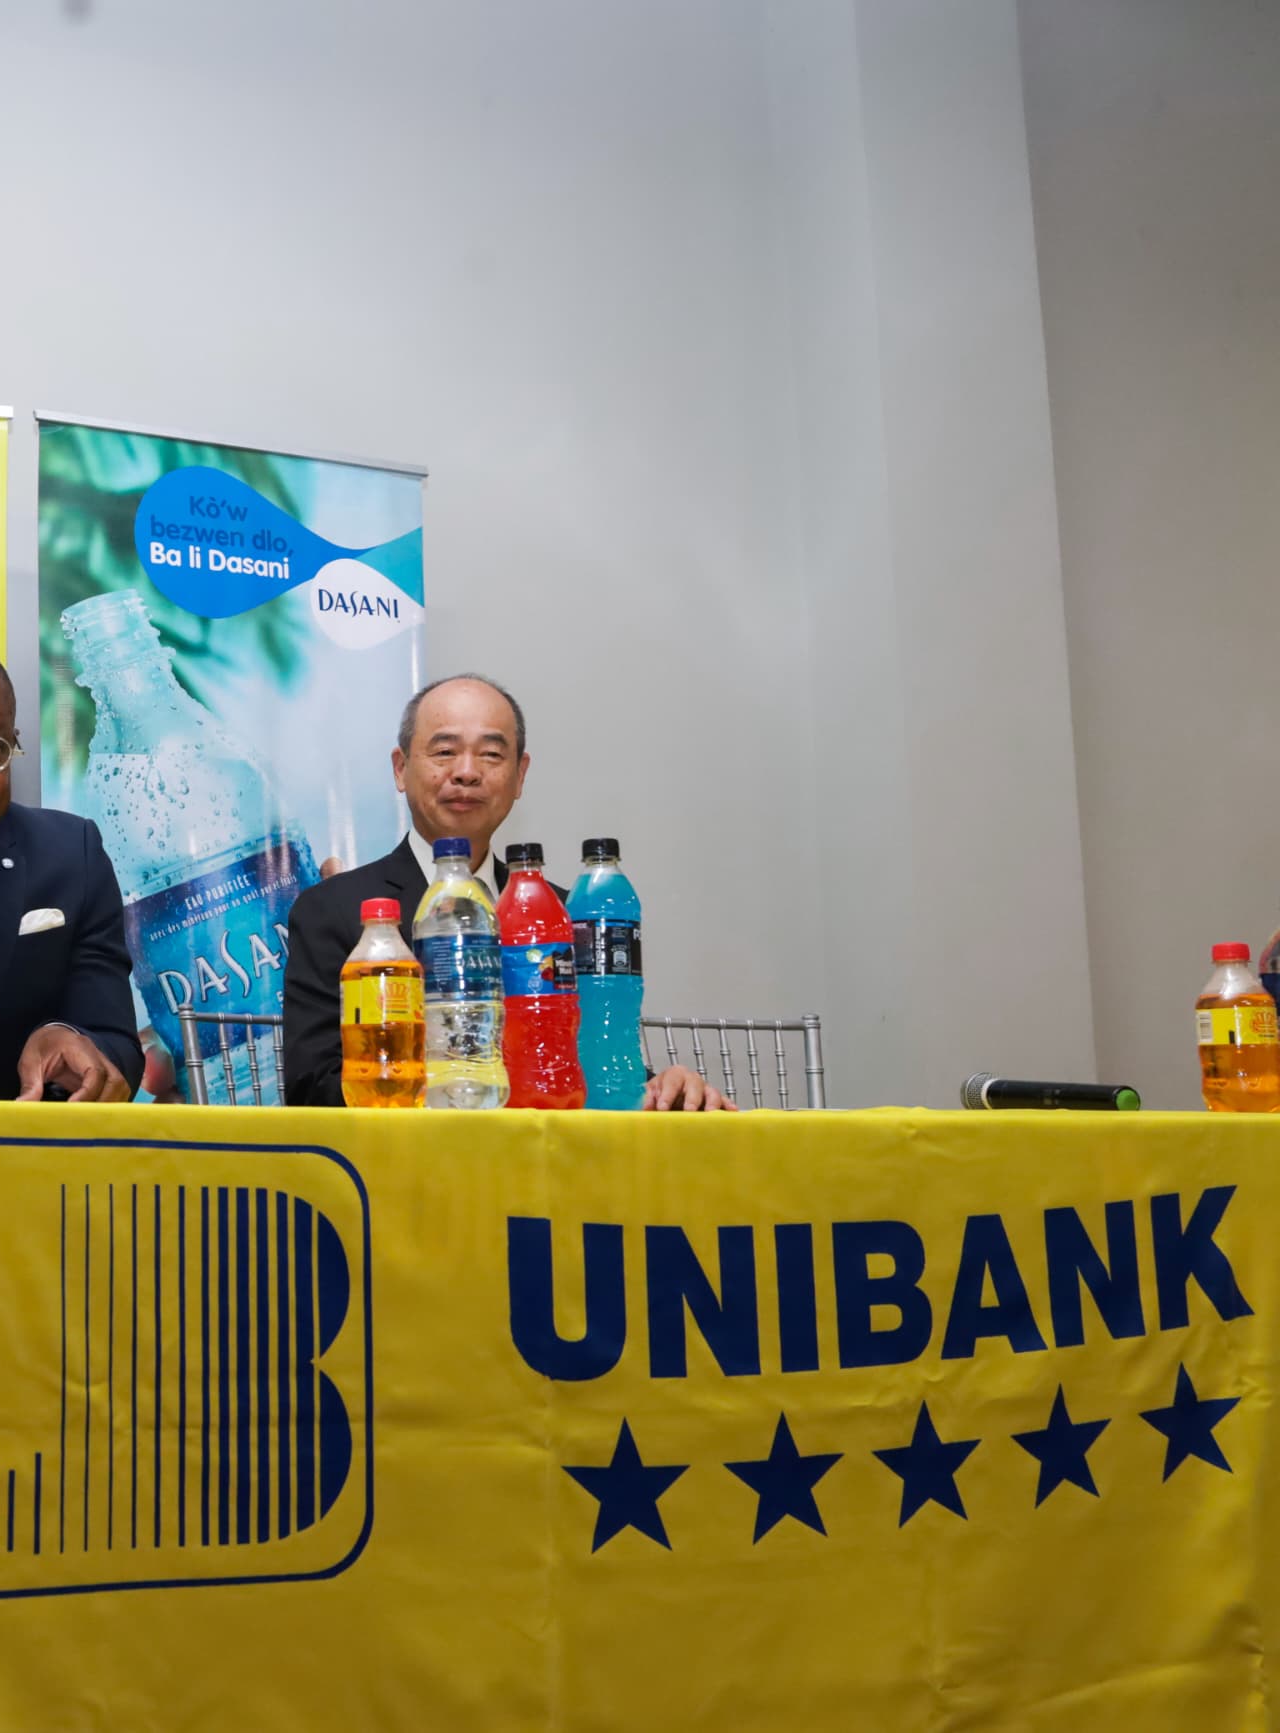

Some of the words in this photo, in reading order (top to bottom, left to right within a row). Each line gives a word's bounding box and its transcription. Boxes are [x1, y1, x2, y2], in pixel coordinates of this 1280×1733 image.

[150, 514, 245, 547] bezwen
[252, 528, 295, 557] dlo,
[149, 541, 182, 567] Ba
[188, 544, 202, 569] li
[208, 548, 290, 580] Dasani
[318, 588, 399, 619] DASANI
[184, 895, 204, 911] EAU
[507, 1184, 1256, 1382] UNIBANK
